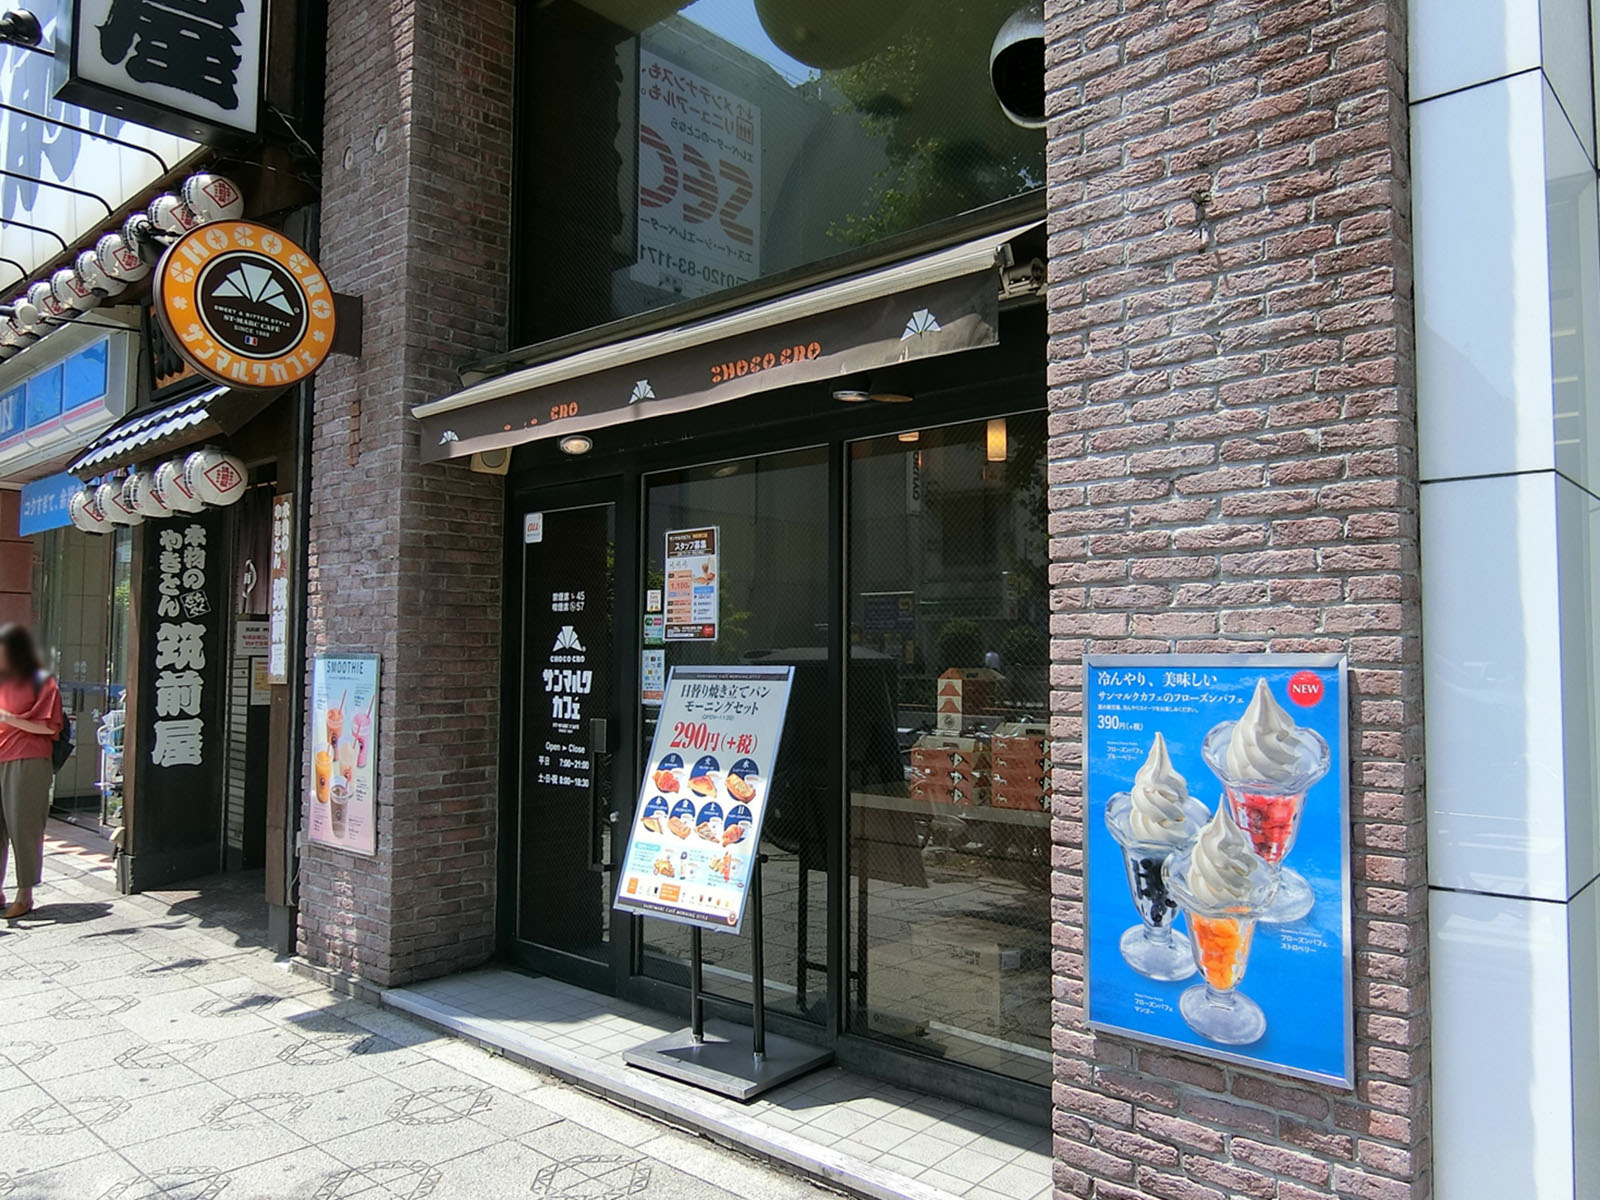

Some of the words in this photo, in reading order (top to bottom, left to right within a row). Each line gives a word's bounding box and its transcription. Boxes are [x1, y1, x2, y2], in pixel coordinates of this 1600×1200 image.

[171, 226, 283, 283] CHOCO
[288, 253, 332, 319] CRO
[182, 323, 317, 384] サンマルクカフェ
[183, 524, 207, 590] 本物の
[157, 529, 183, 618] やきとん
[326, 660, 364, 675] SMOOTHIE
[543, 669, 593, 694] サンマルク
[681, 684, 772, 698] 日替り焼き立てパン
[1292, 683, 1320, 694] NEW
[151, 622, 208, 768] 筑前屋
[552, 695, 580, 720] カフェ
[685, 700, 759, 715] モーニングセット
[545, 741, 561, 752] Open
